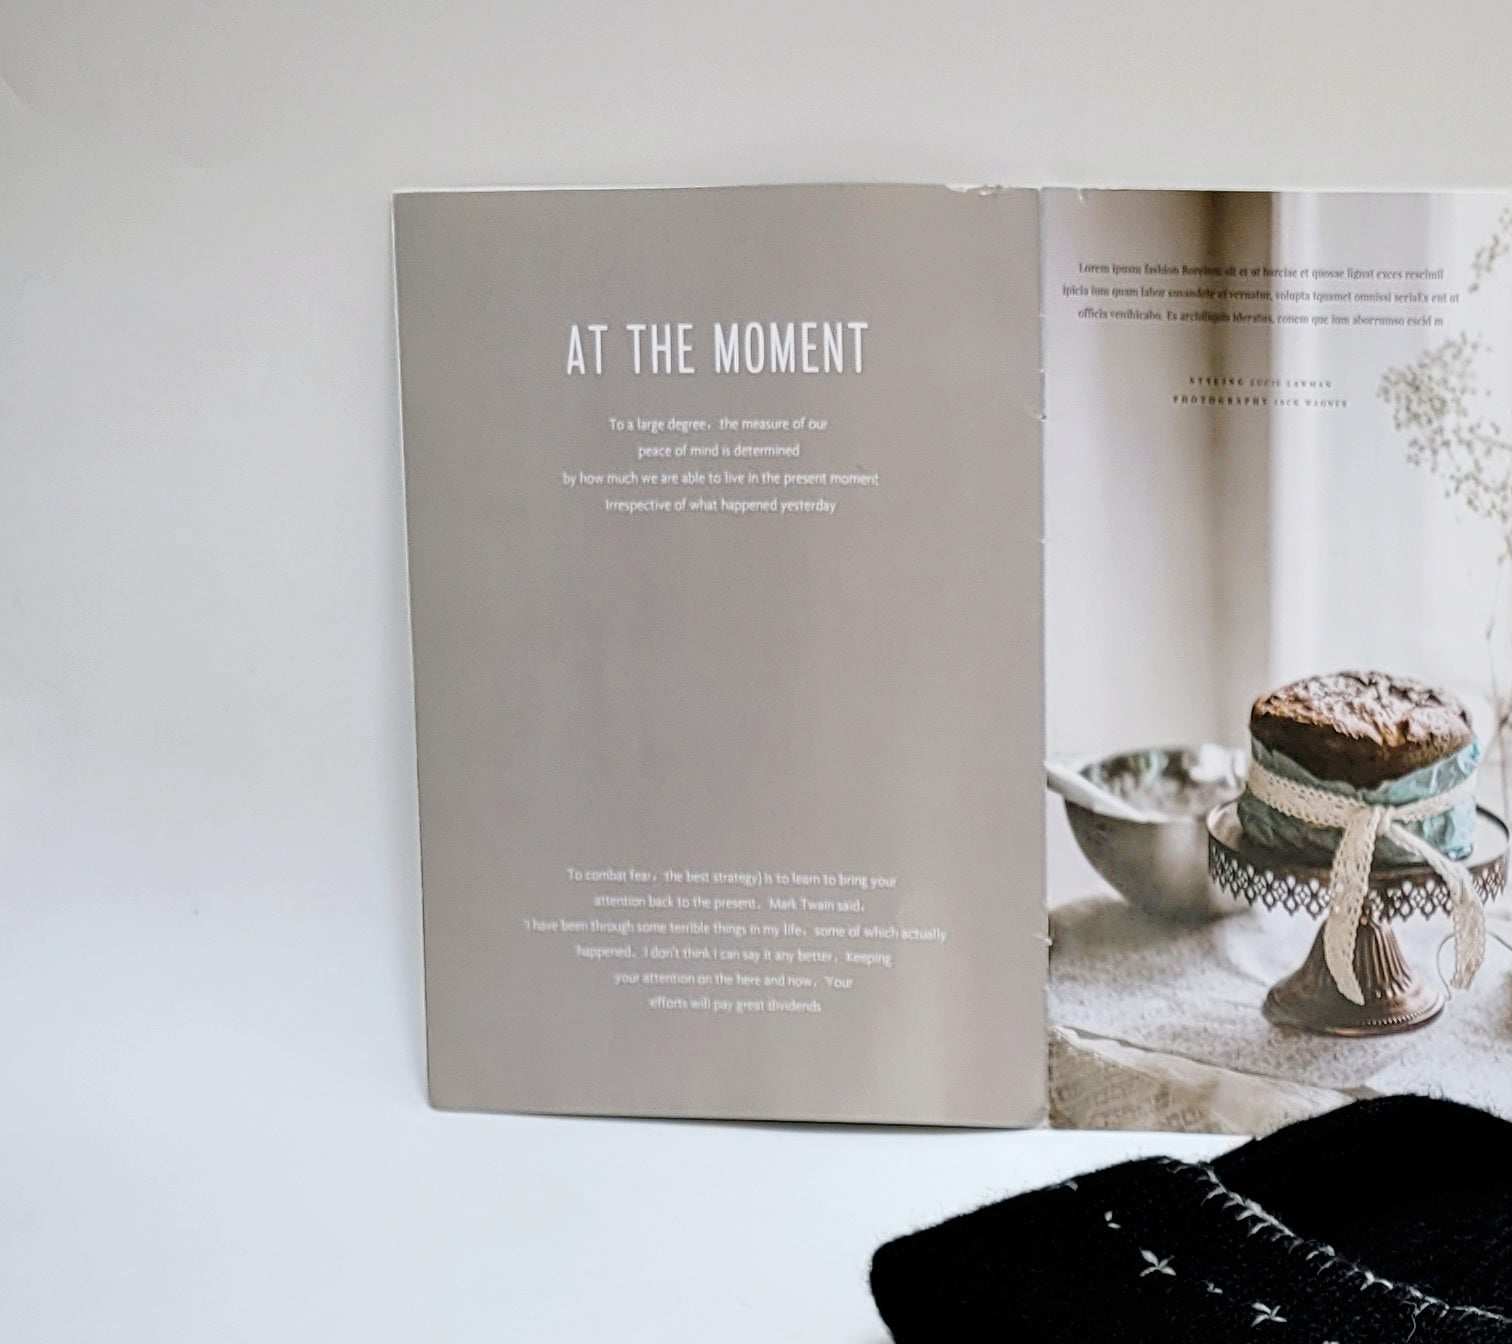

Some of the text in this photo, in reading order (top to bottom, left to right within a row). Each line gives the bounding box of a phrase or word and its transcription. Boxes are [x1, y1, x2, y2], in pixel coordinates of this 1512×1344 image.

[567, 320, 869, 376] AT THE MOMENT
[609, 418, 625, 431] To
[627, 421, 634, 431] a
[637, 417, 666, 434] large
[719, 418, 739, 431] the
[741, 419, 790, 431] measure
[792, 417, 807, 431] of
[808, 420, 828, 431] our
[637, 445, 801, 461] peace of mind is determined
[562, 472, 881, 487] by how much we are able to live in the present moment
[674, 499, 689, 512] of
[689, 499, 719, 512] what
[721, 498, 778, 514] happened
[779, 499, 837, 514] yesterday
[567, 868, 584, 882] To
[664, 869, 684, 882] the
[775, 874, 790, 886] to
[791, 872, 821, 887] learn
[823, 873, 838, 887] to
[839, 873, 868, 890] bring
[870, 877, 897, 890] your
[593, 896, 646, 908] attention
[647, 895, 674, 909] back
[677, 896, 690, 909] to
[692, 896, 711, 909] the
[768, 897, 799, 912] Mark
[800, 899, 835, 913] Twain
[532, 919, 560, 933] have
[590, 919, 635, 936] through
[636, 922, 667, 935] some
[669, 921, 710, 936] terrible
[749, 924, 761, 936] in
[762, 926, 780, 938] my
[814, 926, 846, 938] some
[847, 925, 861, 939] of
[863, 925, 900, 940] which
[901, 927, 948, 944] actually
[643, 948, 650, 959] I
[682, 948, 711, 961] think
[713, 949, 719, 961] I
[719, 951, 741, 962] can
[743, 952, 761, 964] say
[763, 950, 772, 962] it
[774, 952, 794, 964] any
[614, 973, 640, 986] your
[642, 973, 695, 985] attention
[697, 976, 713, 986] on
[714, 973, 734, 986] the
[735, 973, 761, 987] here
[763, 975, 785, 987] and
[823, 975, 854, 989] Your
[690, 996, 711, 1010] will
[713, 1000, 734, 1013] pay
